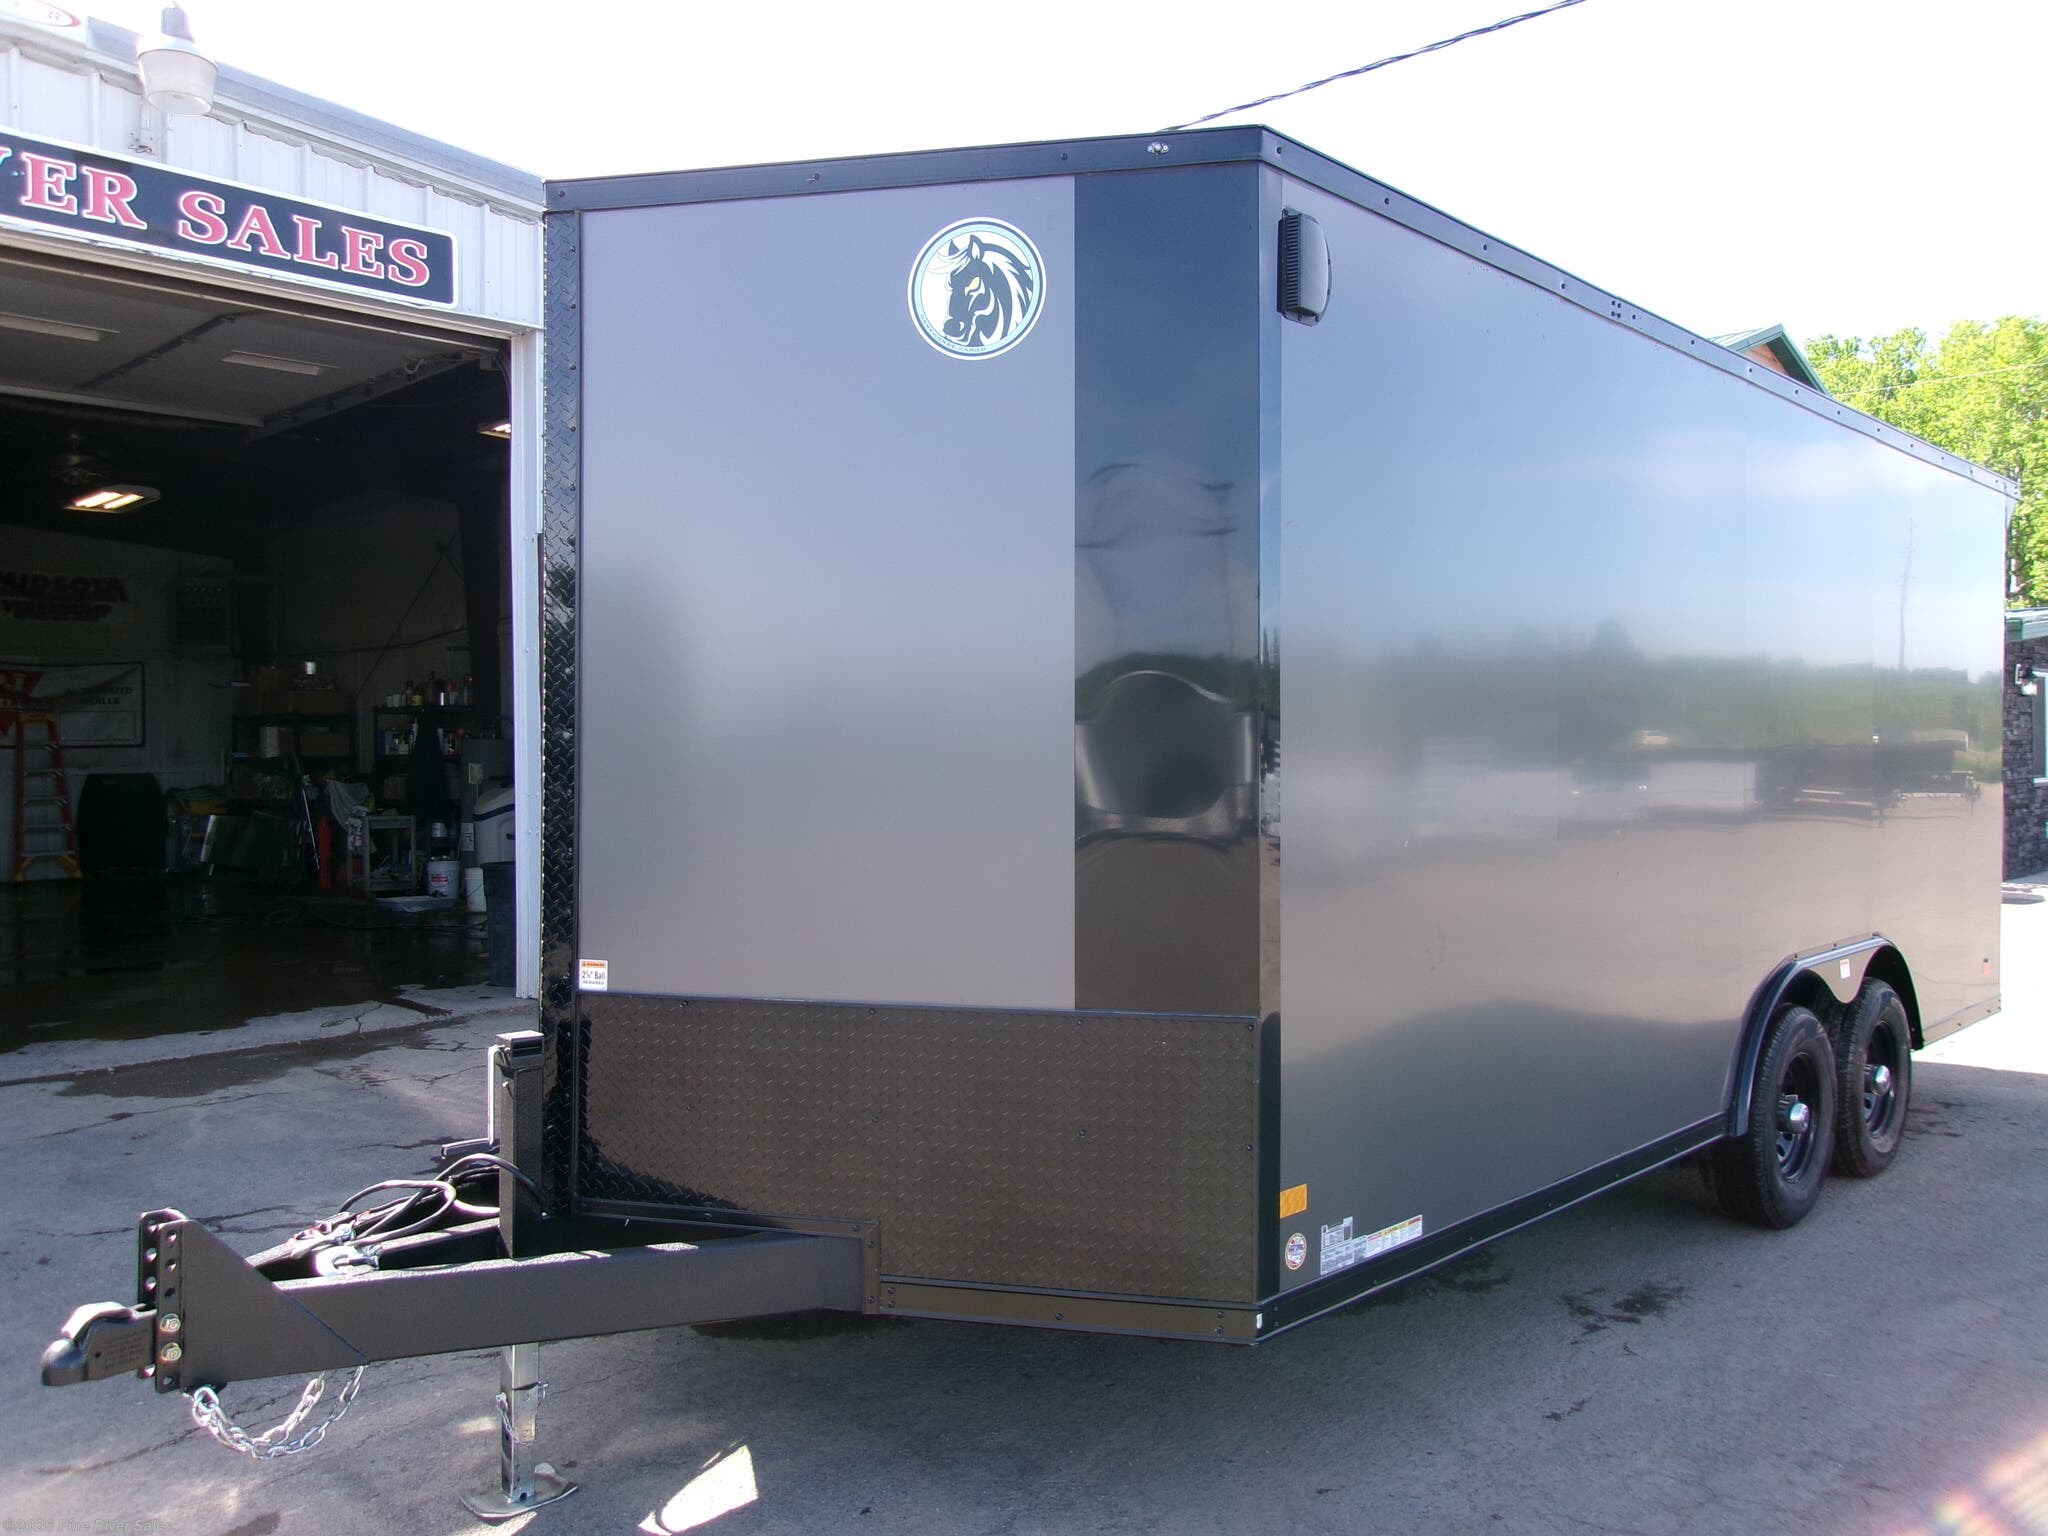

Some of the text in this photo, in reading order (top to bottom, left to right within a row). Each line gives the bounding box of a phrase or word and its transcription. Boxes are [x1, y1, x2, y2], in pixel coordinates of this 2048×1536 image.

[0, 146, 431, 287] ER SALES
[595, 971, 606, 980] Ball
